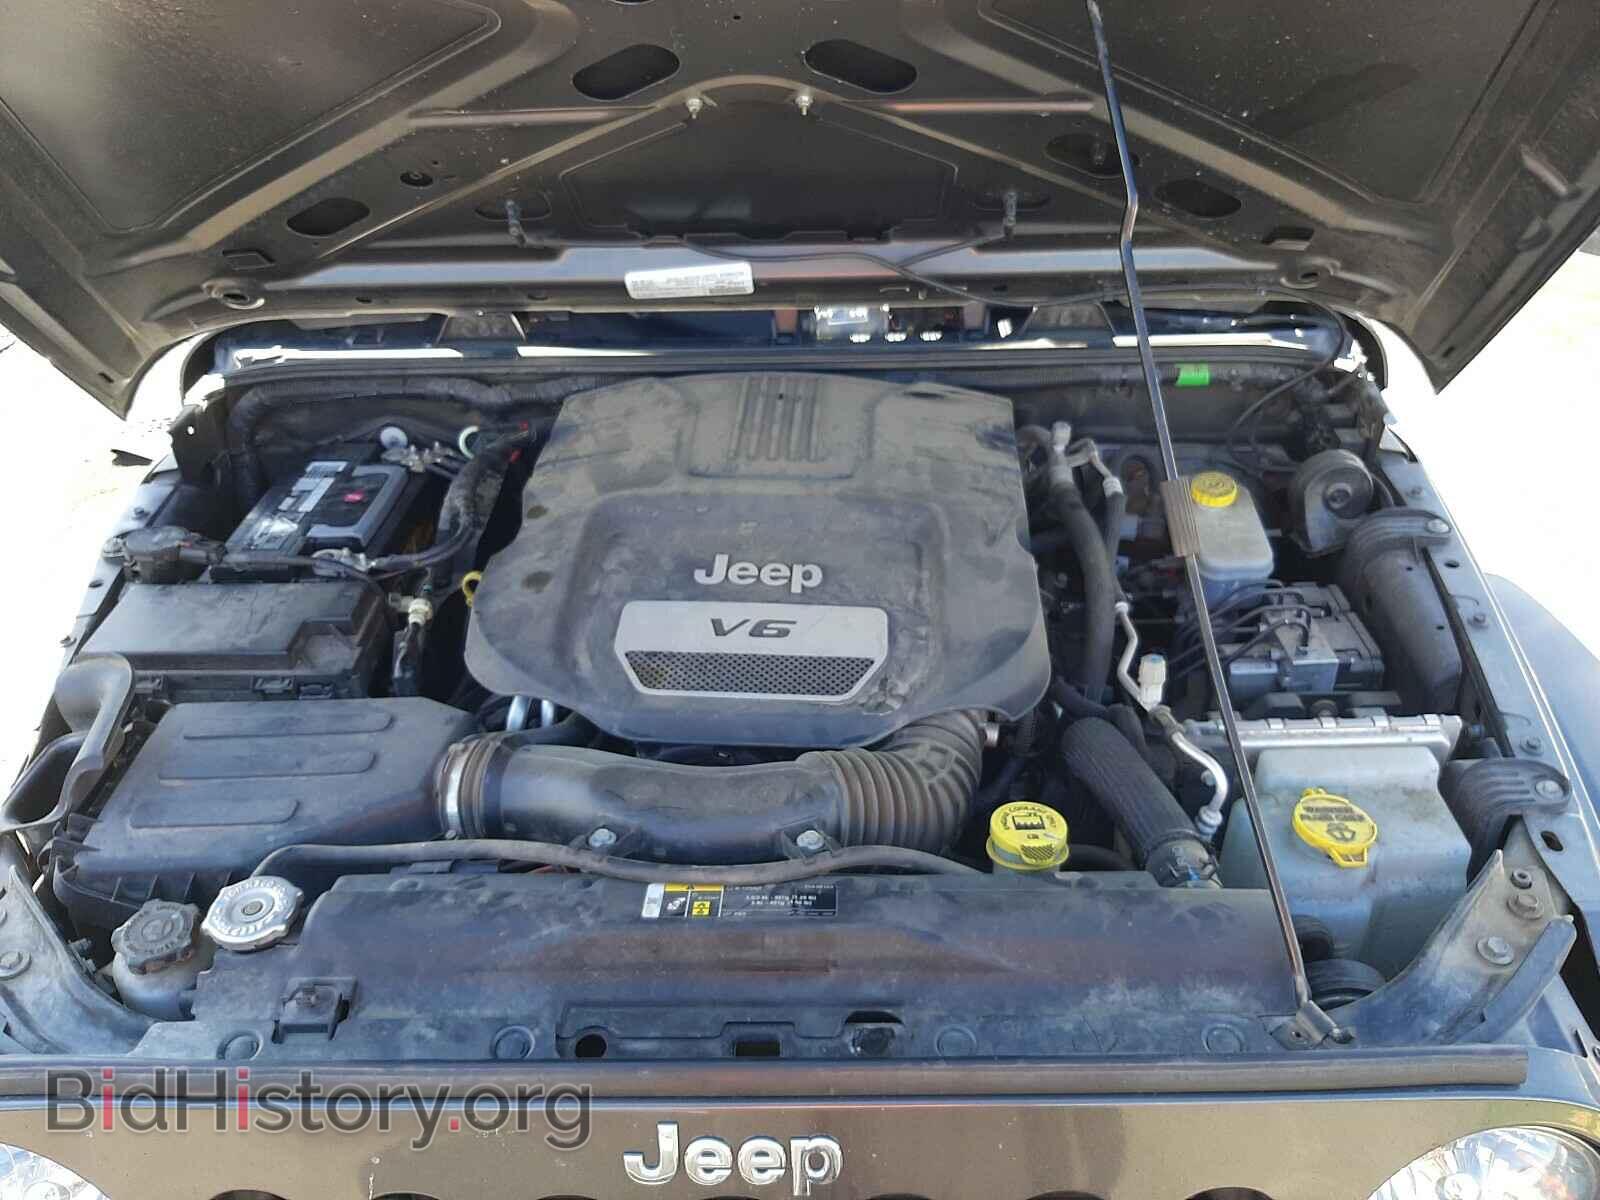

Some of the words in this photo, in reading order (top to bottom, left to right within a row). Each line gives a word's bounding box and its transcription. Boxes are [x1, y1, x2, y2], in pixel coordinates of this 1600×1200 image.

[693, 552, 824, 594] Jeep
[710, 617, 798, 639] V6
[623, 1120, 844, 1196] Jeep
